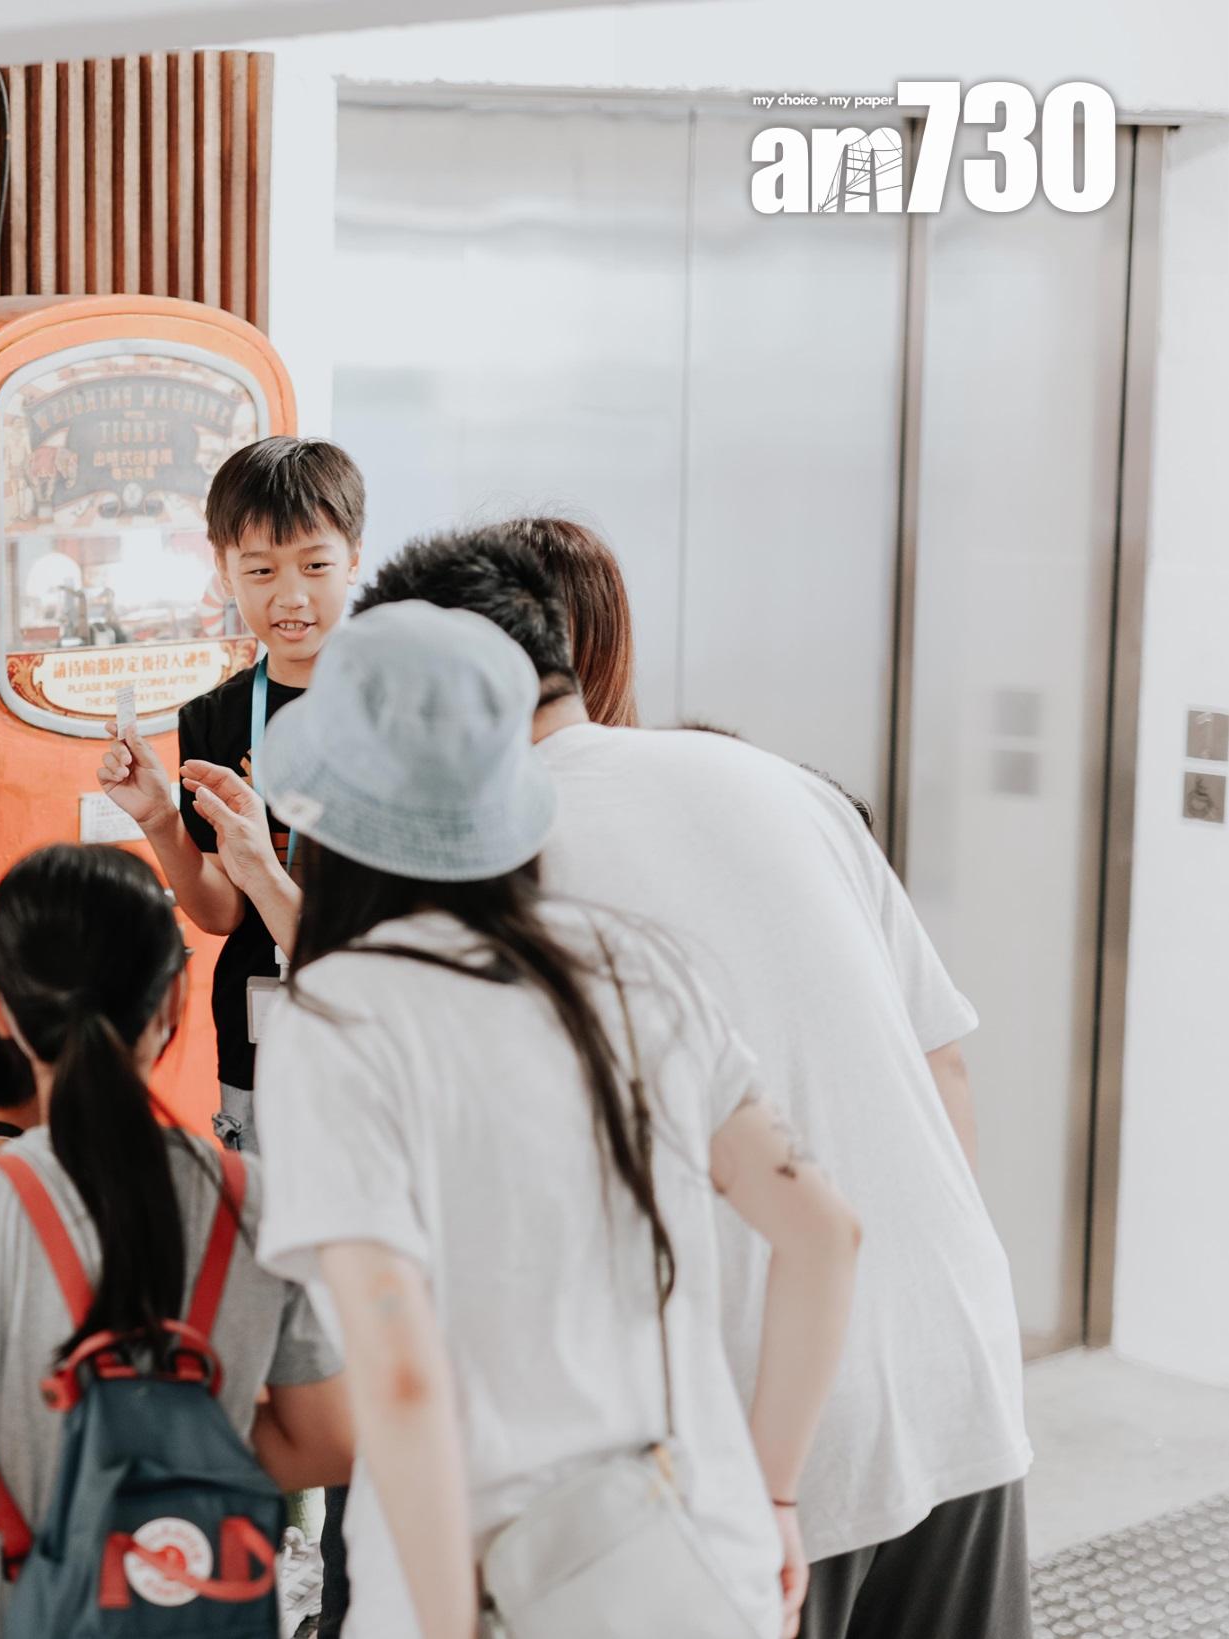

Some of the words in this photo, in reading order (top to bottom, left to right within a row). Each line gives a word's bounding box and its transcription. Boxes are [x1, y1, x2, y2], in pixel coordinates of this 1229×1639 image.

[67, 682, 101, 694] PLEASE
[138, 677, 166, 688] COINS
[168, 674, 197, 686] AFTER
[84, 696, 101, 707] THE
